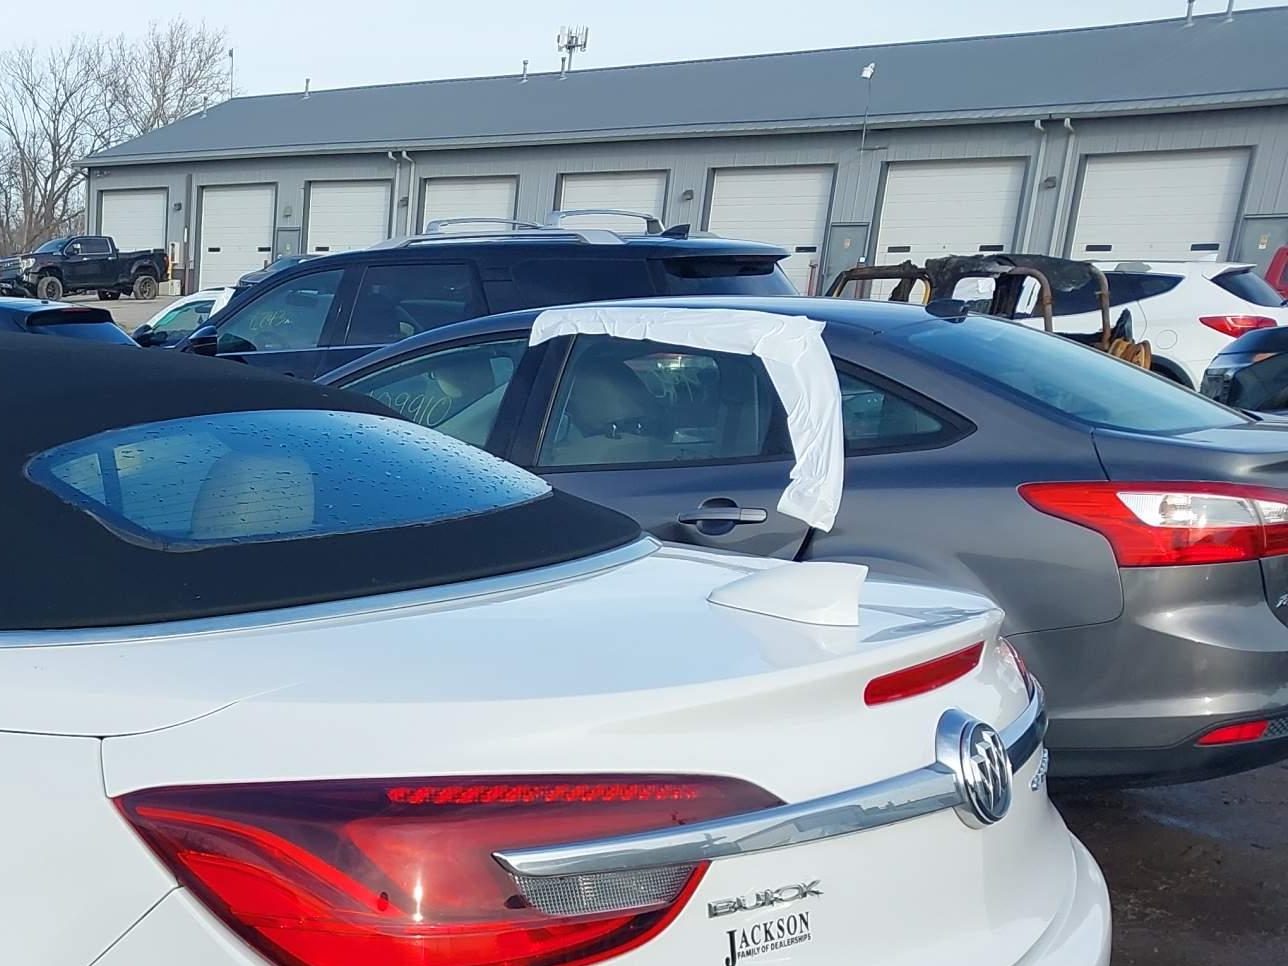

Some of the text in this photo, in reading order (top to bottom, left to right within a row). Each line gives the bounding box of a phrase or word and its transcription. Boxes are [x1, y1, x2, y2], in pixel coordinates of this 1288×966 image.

[707, 880, 825, 918] BUICK
[737, 933, 812, 960] FAMILY OF DEALERSHIPS
